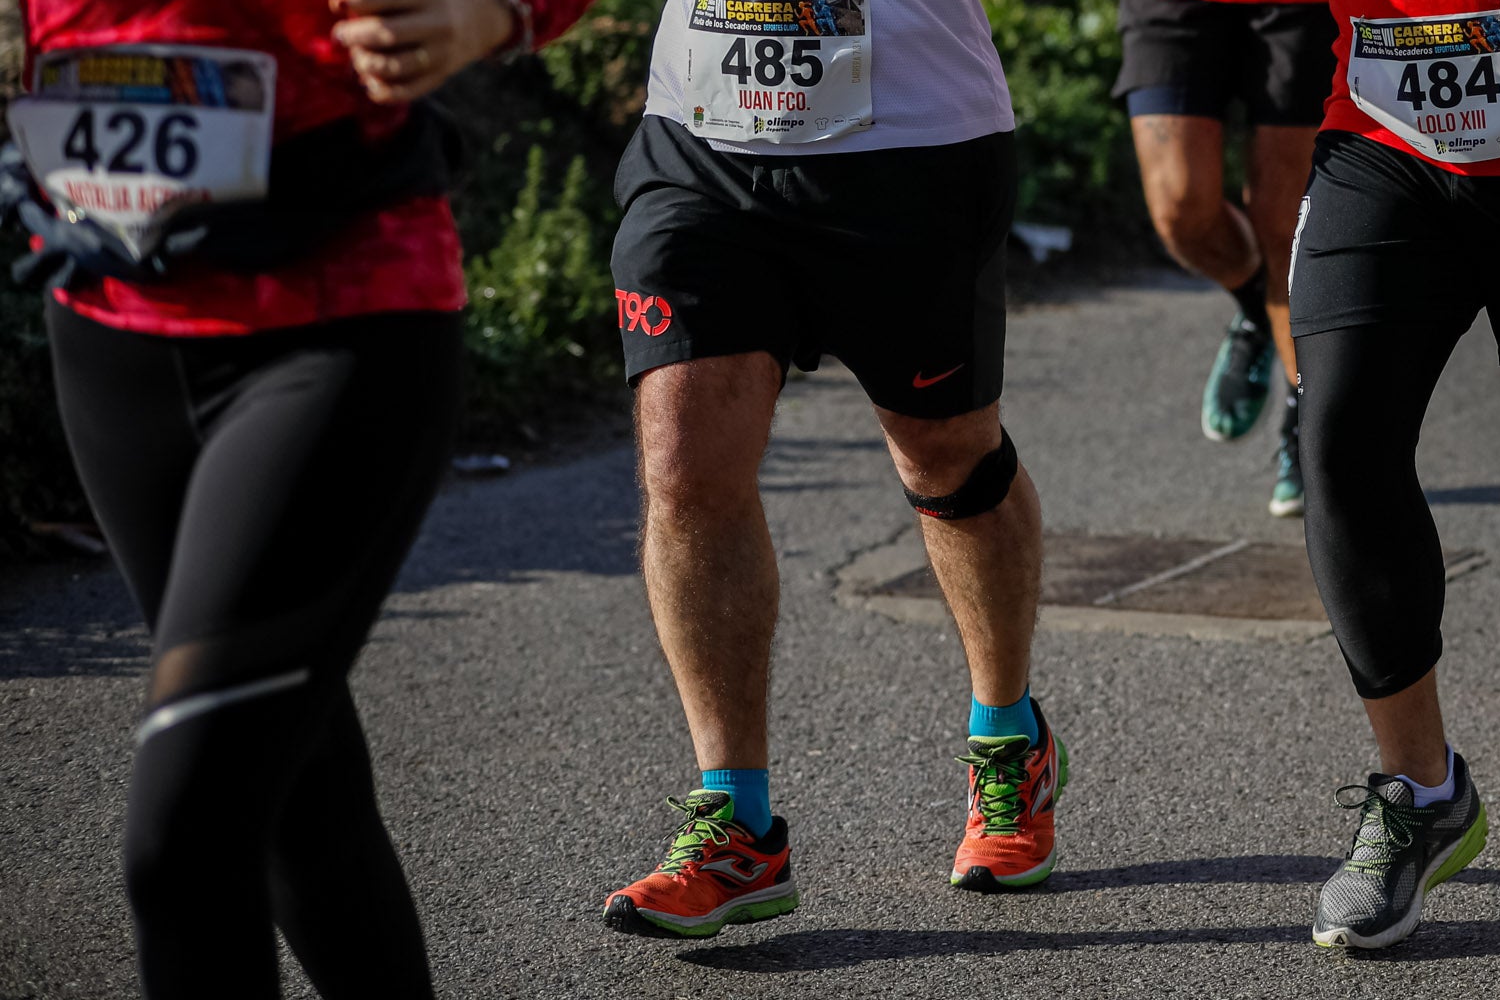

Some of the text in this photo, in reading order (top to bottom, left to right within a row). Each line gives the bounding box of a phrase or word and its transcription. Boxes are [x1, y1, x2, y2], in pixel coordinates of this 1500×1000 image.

[726, 0, 794, 13] CARRERA
[693, 16, 762, 31] Ruta de los Secaderos
[727, 12, 794, 22] POPULAR
[1360, 27, 1372, 40] 26
[1381, 23, 1462, 47] VII CARRERA
[1395, 34, 1464, 46] POPULAR
[1362, 46, 1377, 54] Ruta
[1394, 47, 1433, 56] Secaderos
[721, 38, 824, 87] 485
[738, 90, 811, 111] JUAN FCO.
[767, 118, 805, 128] olimpo
[1417, 109, 1486, 135] LOLO XIII
[63, 106, 200, 179] 426
[1448, 137, 1486, 148] olimpo
[615, 288, 672, 336] T90
